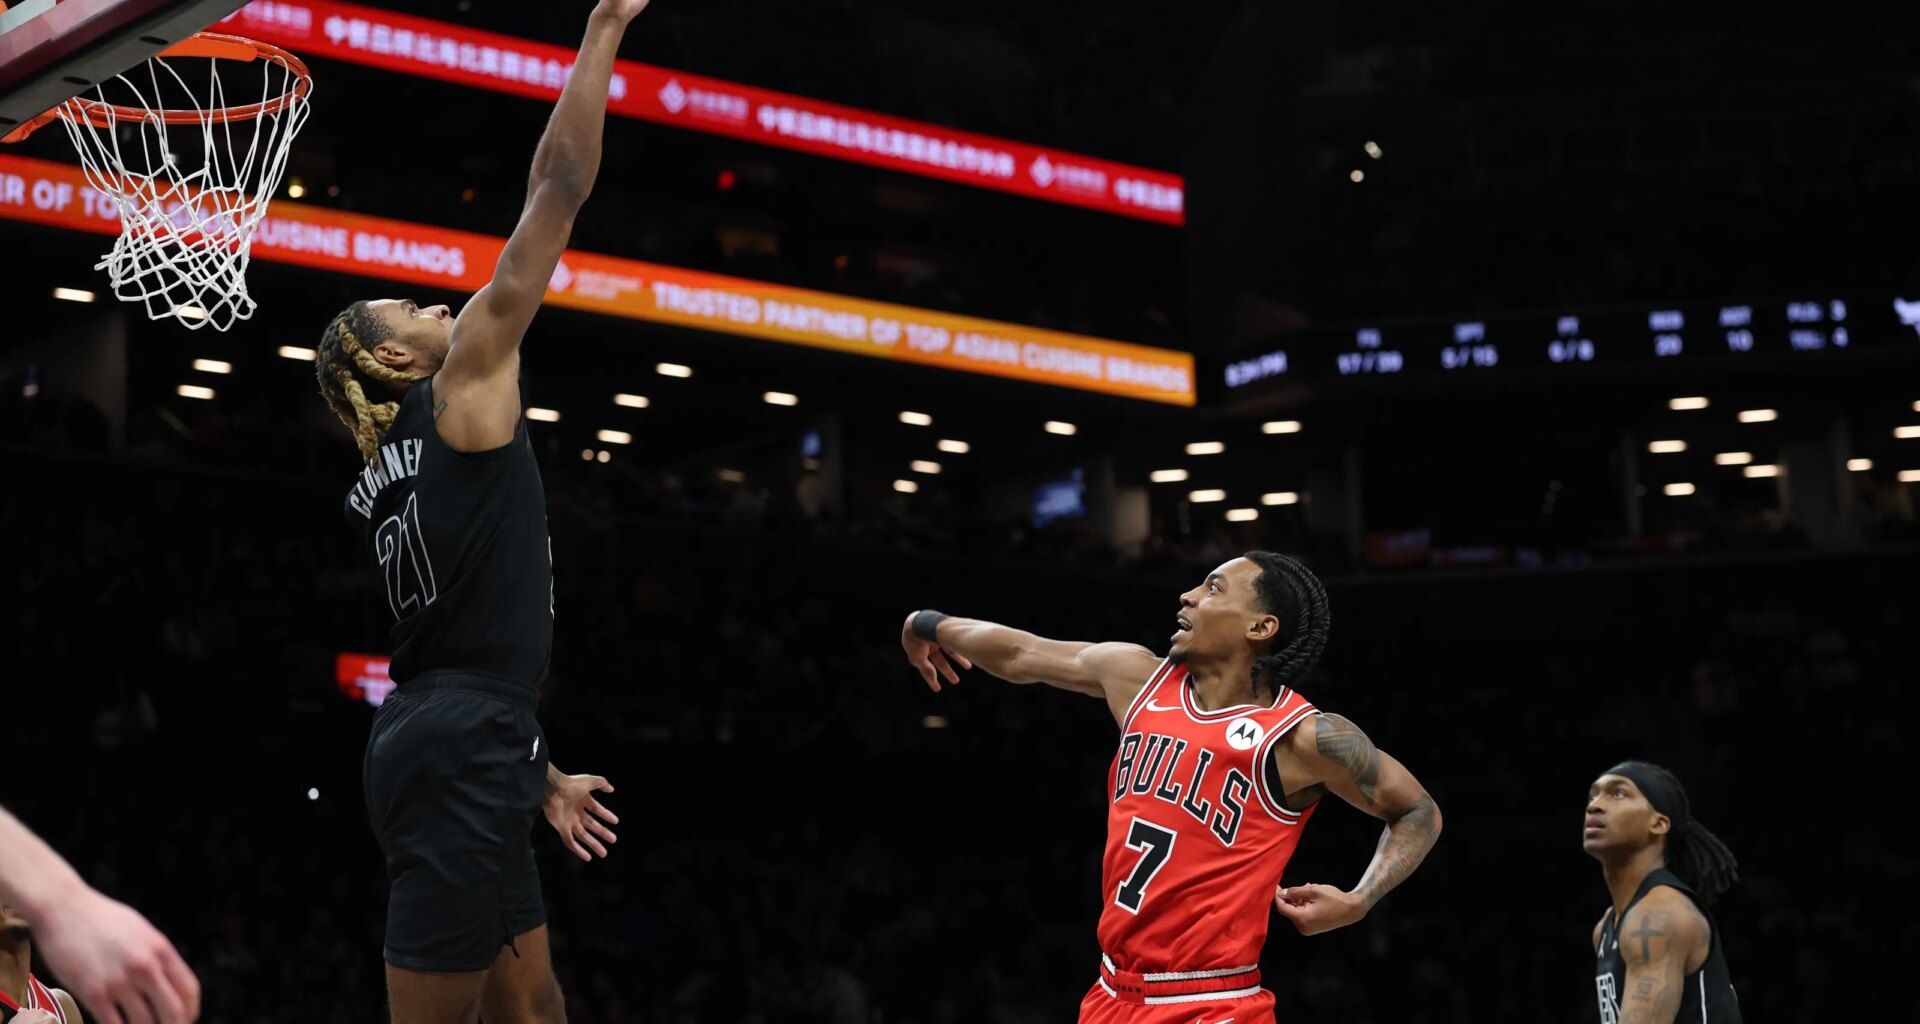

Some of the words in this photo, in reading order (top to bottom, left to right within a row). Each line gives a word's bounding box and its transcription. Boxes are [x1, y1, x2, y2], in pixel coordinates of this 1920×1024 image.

[32, 179, 73, 212] OF
[80, 187, 139, 222] TOP
[353, 231, 465, 277] BRANDS
[652, 281, 761, 324] TRUSTED
[764, 300, 867, 341] PARTNER
[870, 317, 901, 346] OF
[905, 323, 950, 353] TOP
[953, 331, 1020, 366] ASIAN
[1022, 343, 1102, 380] CUISINE
[1105, 355, 1190, 393] BRANDS
[350, 438, 423, 519] CLOWNEY
[375, 491, 437, 622] 21
[1113, 731, 1253, 848] BULLS
[1114, 815, 1178, 916] 7
